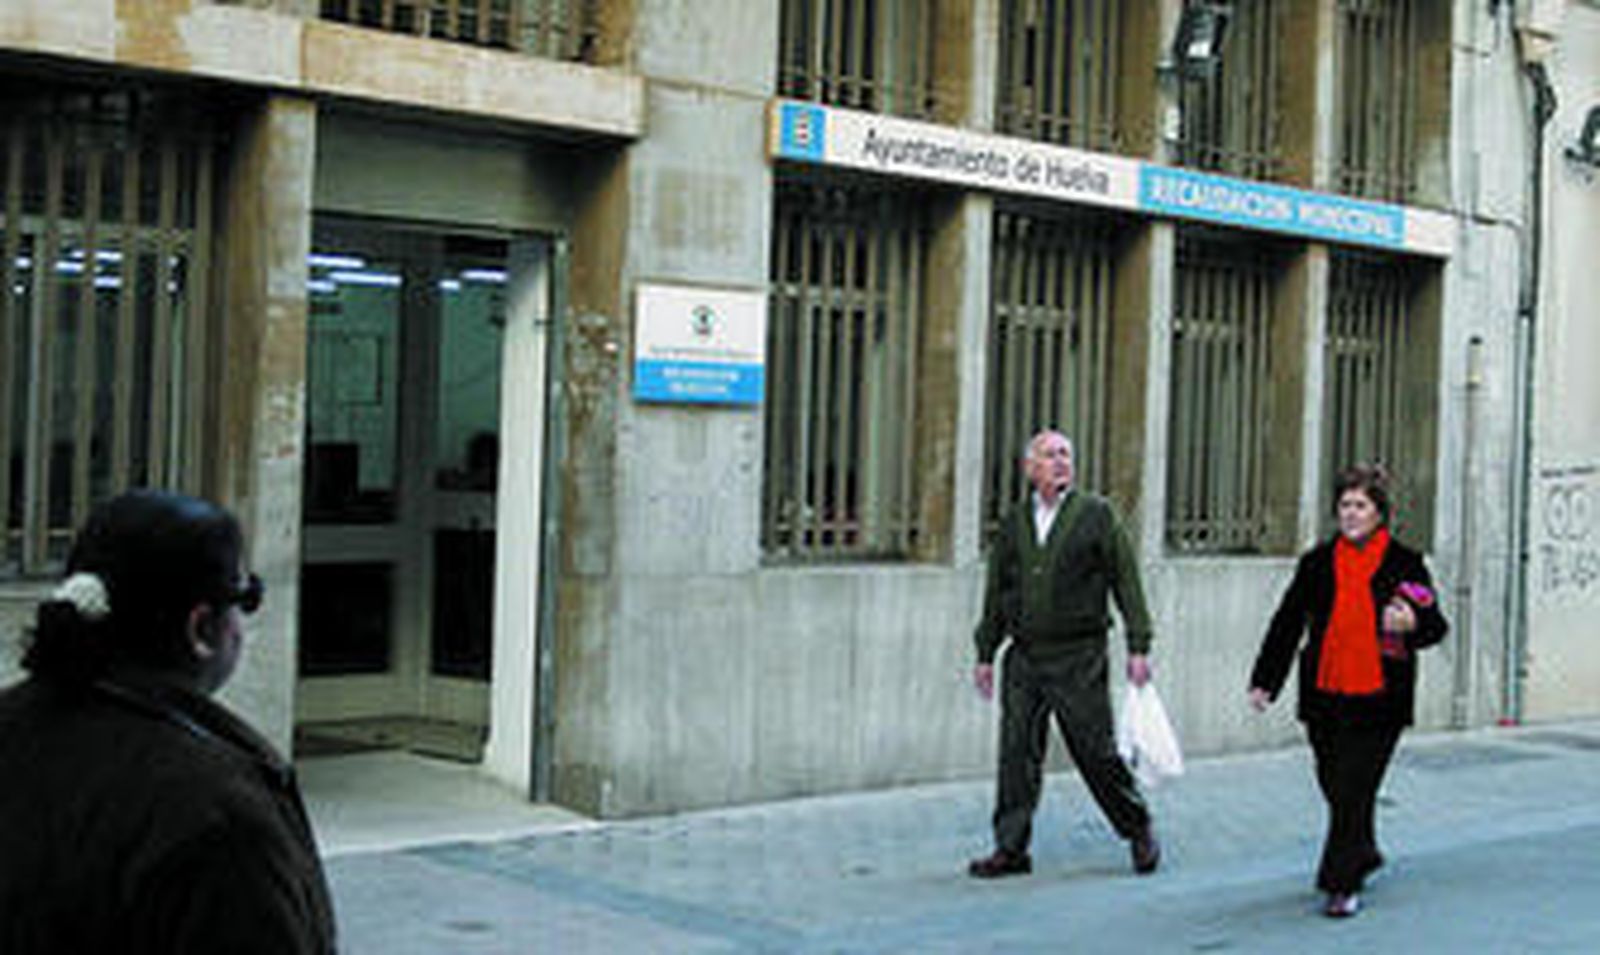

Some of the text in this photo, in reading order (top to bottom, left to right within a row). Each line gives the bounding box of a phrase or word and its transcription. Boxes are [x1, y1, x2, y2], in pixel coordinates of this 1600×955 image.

[862, 129, 1110, 195] Ayuntamiento de Huelva
